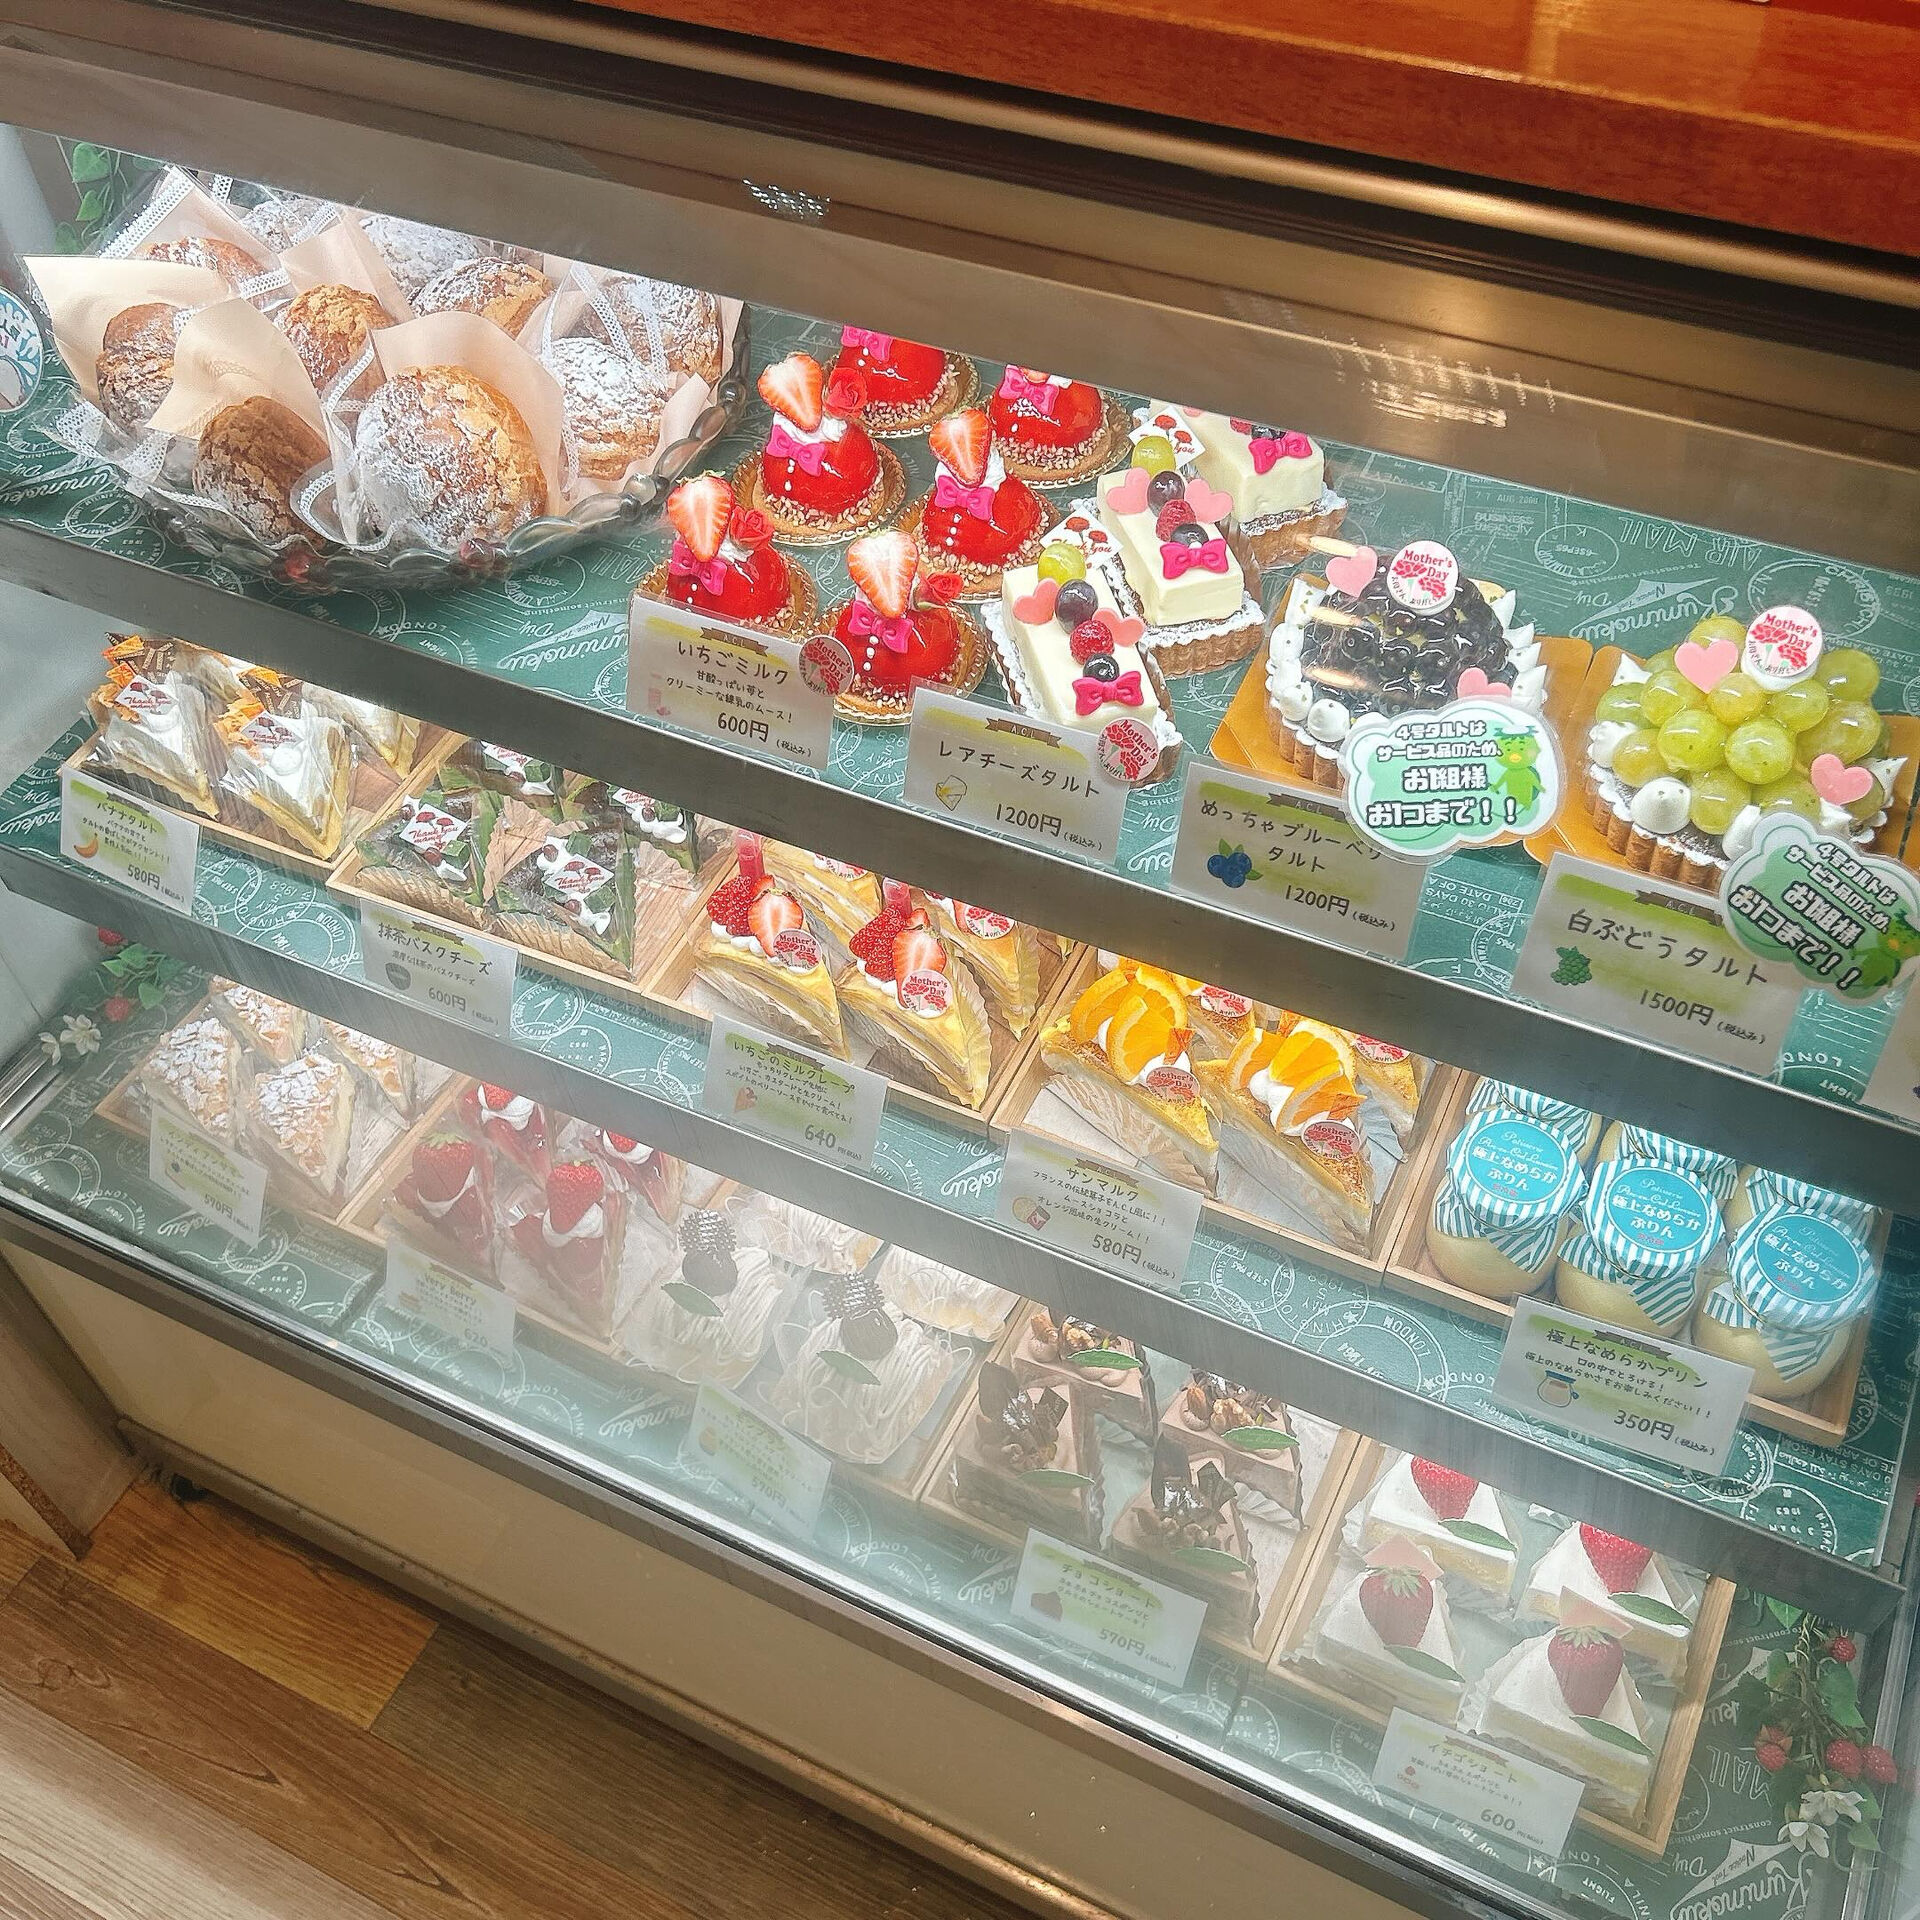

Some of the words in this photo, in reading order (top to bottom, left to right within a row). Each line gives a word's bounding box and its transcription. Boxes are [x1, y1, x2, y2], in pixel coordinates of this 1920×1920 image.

[1403, 549, 1453, 569] Mother's
[1427, 566, 1450, 581] Day
[1765, 612, 1818, 638] Mother's
[814, 638, 852, 674] Mother's
[1788, 634, 1814, 651] Day
[678, 640, 788, 685] いちごミルク
[828, 662, 846, 682] Day
[666, 676, 793, 723] クリーミーな練乳のムース！
[696, 669, 766, 699] 甘酸っぱい苺と
[717, 712, 769, 743] 600円
[1119, 718, 1159, 761] Mother's
[1395, 720, 1486, 742] 4号タルトは
[1130, 747, 1149, 768] Day
[1376, 741, 1504, 763] サービス品のため、
[938, 740, 1100, 799] レアチーズタルト
[1402, 765, 1489, 793] お1組様
[96, 802, 158, 835] バナナタルト
[995, 803, 1063, 838] 1200円
[1200, 799, 1385, 861] めっちゃブルーベリ
[1267, 845, 1327, 874] タルト
[1816, 841, 1900, 908] 4号タルトは
[127, 864, 161, 891] 580円
[1784, 844, 1892, 935] サービス品のため、
[1284, 884, 1351, 917] 1200円
[1781, 880, 1866, 950] お1組様
[377, 921, 493, 976] 抹茶バスクチーズ
[1565, 908, 1770, 988] 白ぶどうタルト
[427, 986, 468, 1012] 600円
[908, 974, 948, 990] Mother's
[928, 985, 947, 997] Day
[1638, 990, 1716, 1027] 1500円
[732, 1040, 856, 1096] いちごのミルクレープ
[803, 1124, 837, 1150] 640
[1312, 1123, 1356, 1138] Mother's
[1334, 1134, 1355, 1147] Day
[1471, 1145, 1559, 1185] 極上なめらか
[1065, 1167, 1140, 1203] サンマルク
[1611, 1194, 1702, 1232] 極上なめらか
[1091, 1233, 1142, 1266] 580円
[1762, 1232, 1848, 1290] 極上なめらか
[1546, 1328, 1708, 1389] 極上なめらかプリン
[1576, 1357, 1665, 1392] 口の中でとろける！
[1613, 1409, 1675, 1441] 350円
[1061, 1563, 1157, 1609] チョコショート
[1099, 1628, 1146, 1657] 570円
[1427, 1742, 1518, 1784] イチゴショート
[1480, 1808, 1517, 1832] 600
